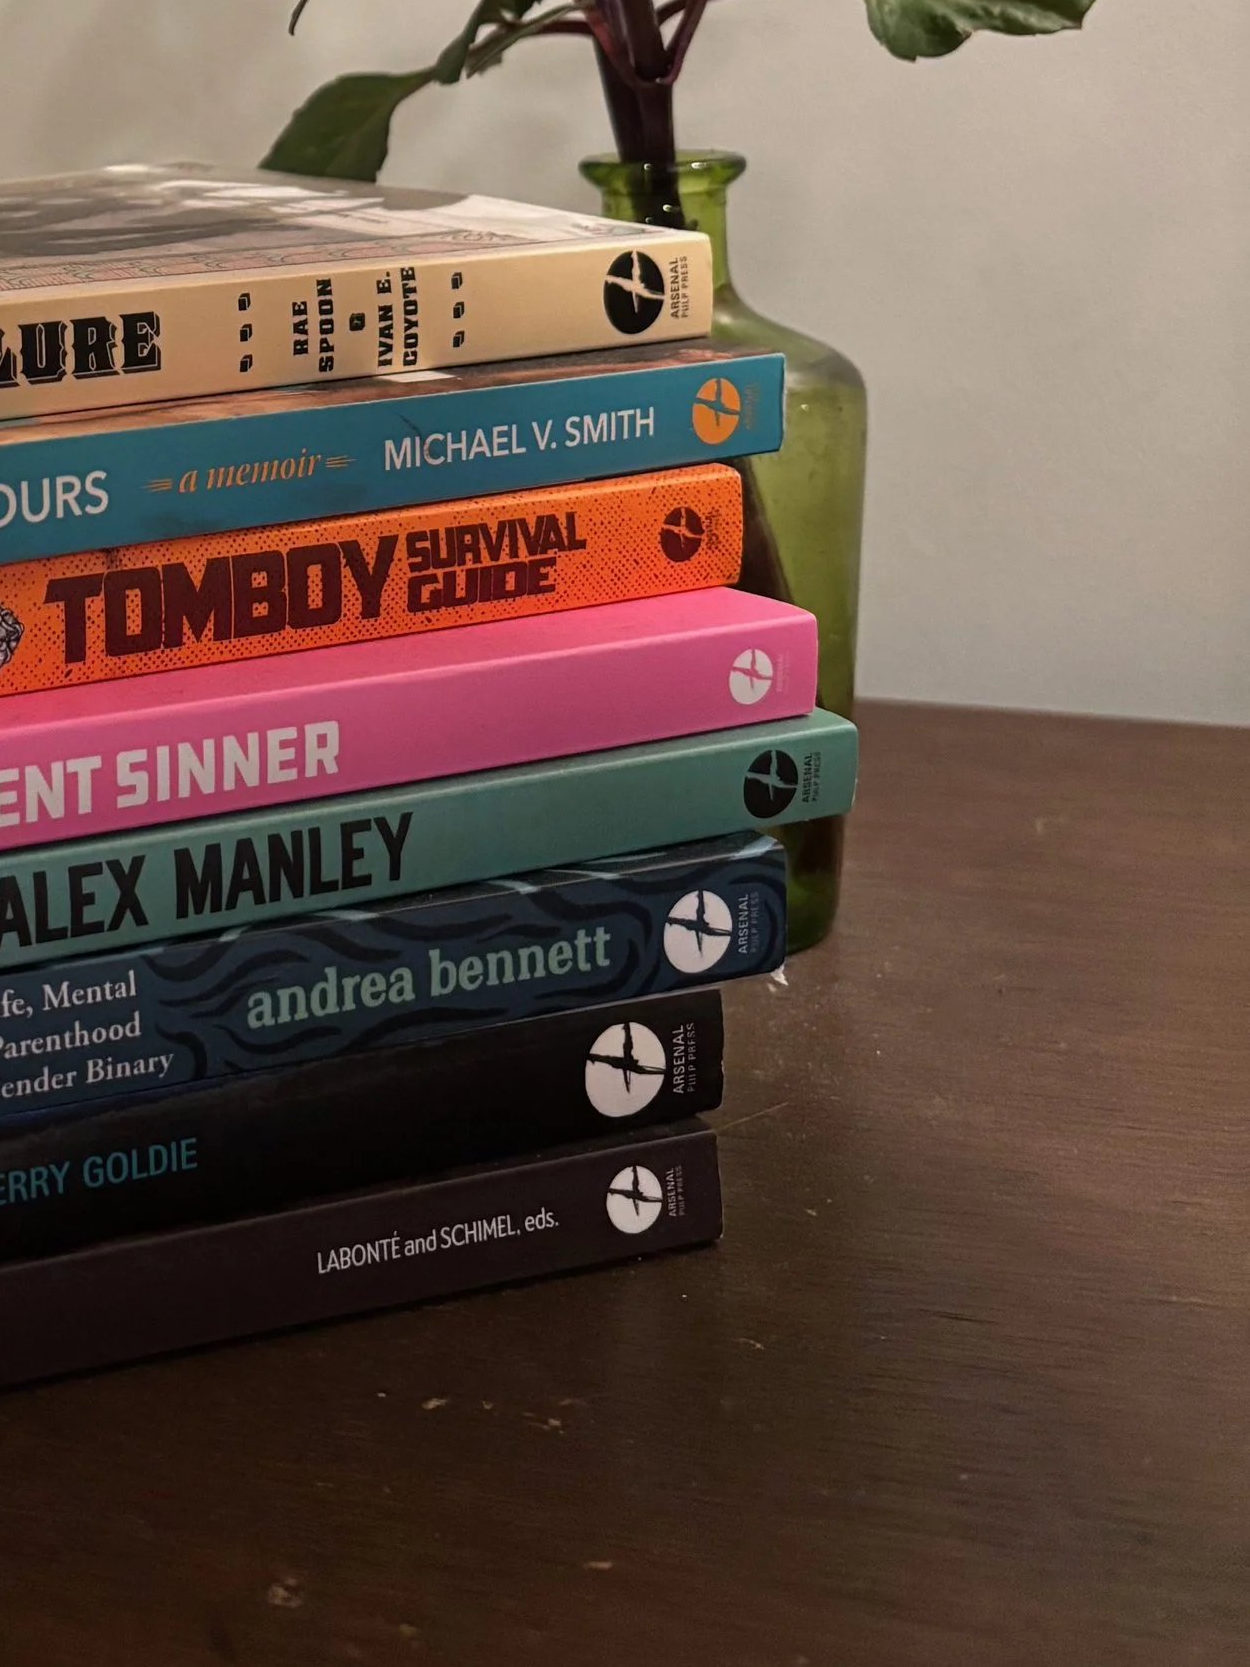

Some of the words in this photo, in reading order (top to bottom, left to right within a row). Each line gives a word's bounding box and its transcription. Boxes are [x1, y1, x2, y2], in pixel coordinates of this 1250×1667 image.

[376, 271, 392, 294] E.
[670, 257, 680, 318] ARSENAL
[292, 301, 308, 355] RAE
[316, 278, 334, 372] SPOON
[377, 304, 393, 367] IVAN
[400, 266, 418, 366] COYOTE
[179, 469, 198, 493] a
[207, 447, 322, 490] memoir
[384, 424, 526, 472] MICHAEL
[532, 419, 557, 451] V.
[565, 407, 655, 448] SMITH
[43, 534, 400, 664] TOMBOY
[406, 511, 587, 573] SURVIVAL
[406, 556, 557, 613] GUIDE
[116, 720, 340, 809] SINNER
[174, 811, 414, 919] MANLEY
[738, 894, 749, 954] ARSENAL
[42, 969, 137, 1012] Mental
[246, 965, 416, 1029] andrea
[429, 926, 610, 997] bennett
[85, 1052, 174, 1085] Binary
[673, 1024, 685, 1094] ARSENAL
[82, 1137, 198, 1188] GOLDIE
[317, 1230, 401, 1274] LABONTÉ
[404, 1230, 437, 1256] and
[440, 1214, 521, 1250] SCHIMEL,
[524, 1206, 559, 1232] eds.
